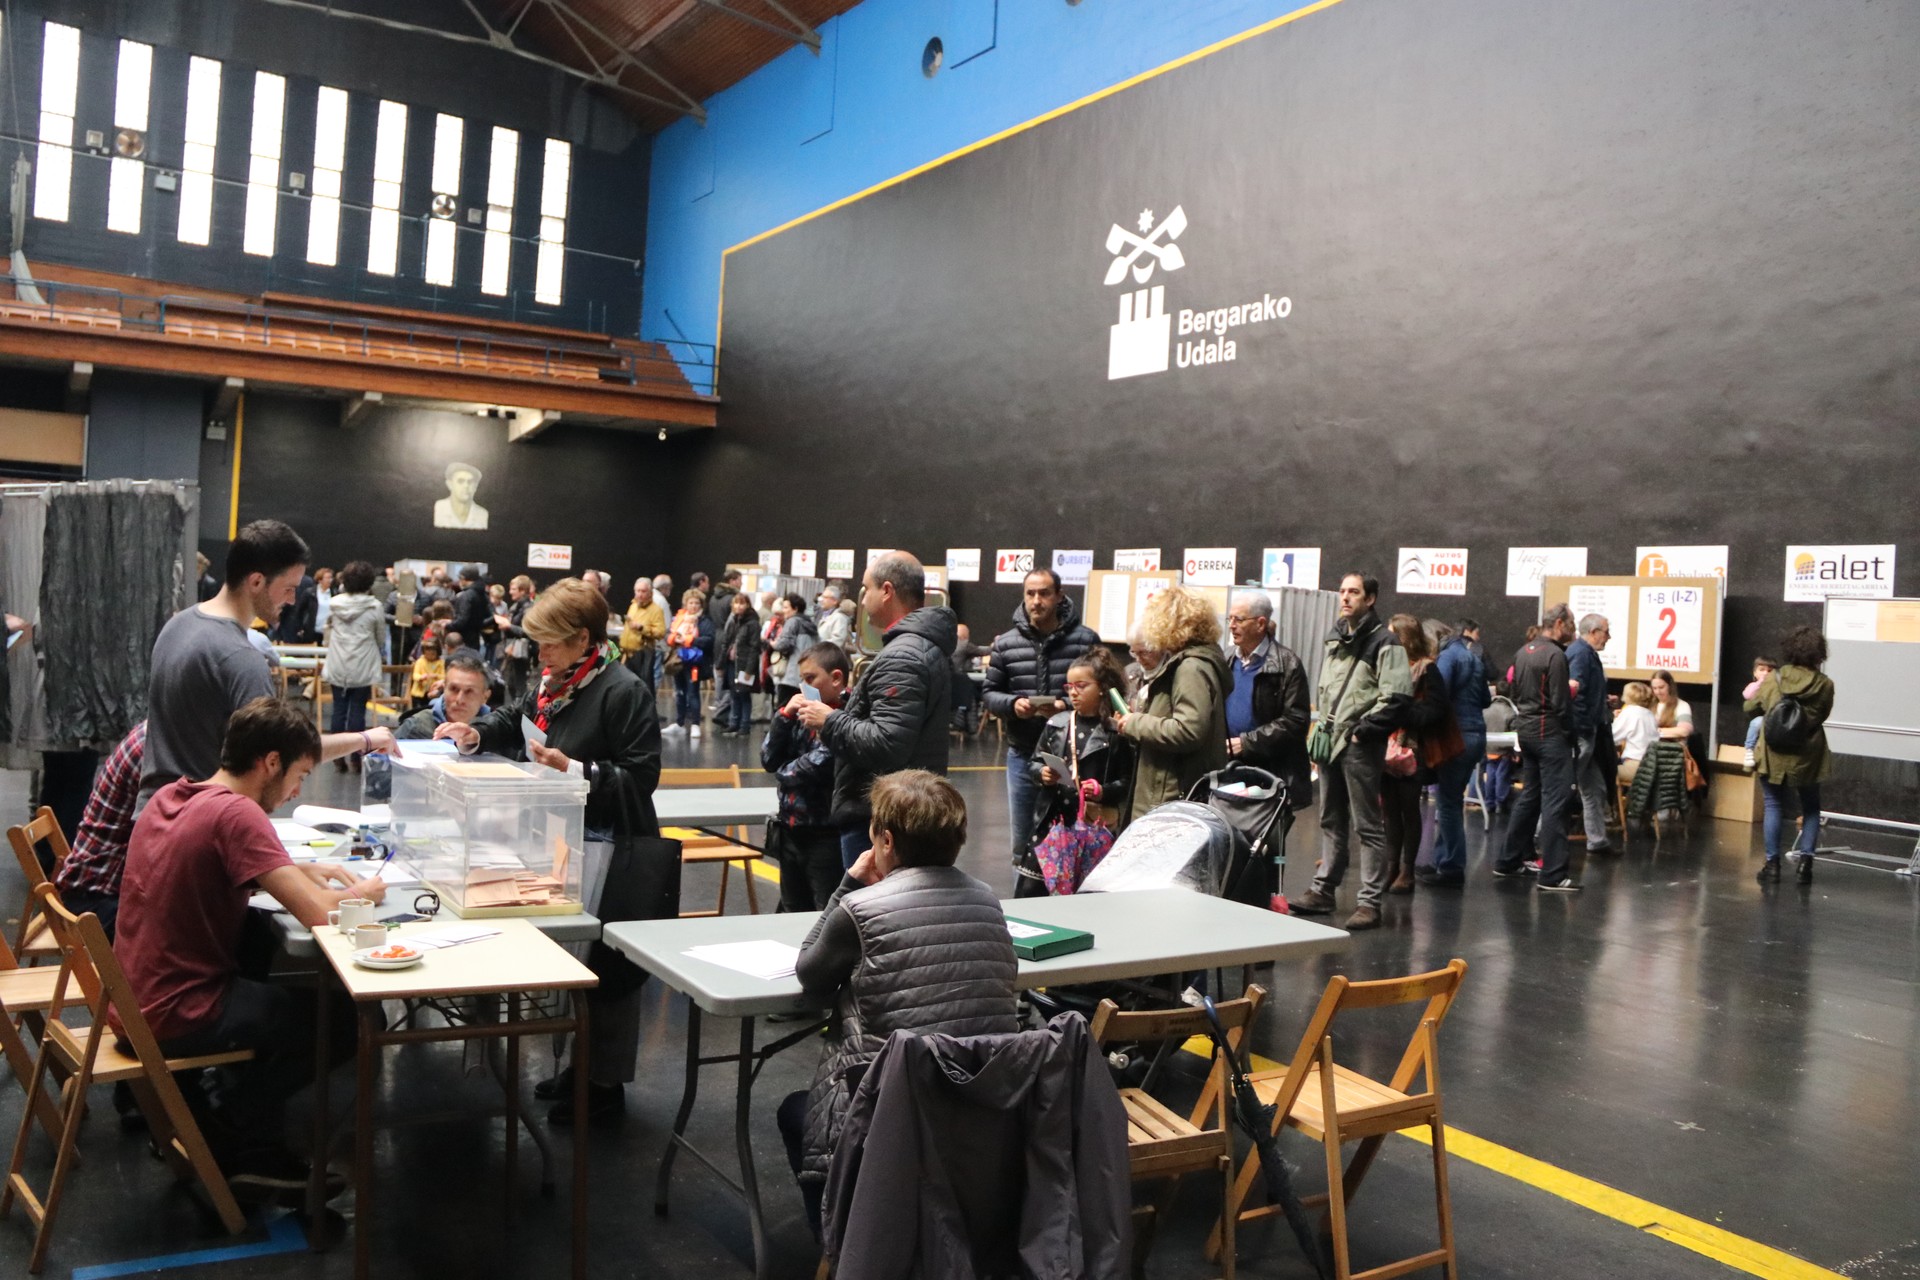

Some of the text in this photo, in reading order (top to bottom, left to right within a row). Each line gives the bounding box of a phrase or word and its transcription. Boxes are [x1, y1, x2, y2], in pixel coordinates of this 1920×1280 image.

[1178, 293, 1292, 336] Bergarako
[1176, 336, 1237, 369] Udala
[1065, 555, 1092, 565] URBIETA
[1198, 560, 1233, 571] ERREKA
[1820, 553, 1885, 580] alet
[1429, 563, 1464, 577] ION
[1428, 581, 1463, 590] BERGARA
[1656, 607, 1677, 649] 2
[1646, 653, 1690, 669] MAHAIA
